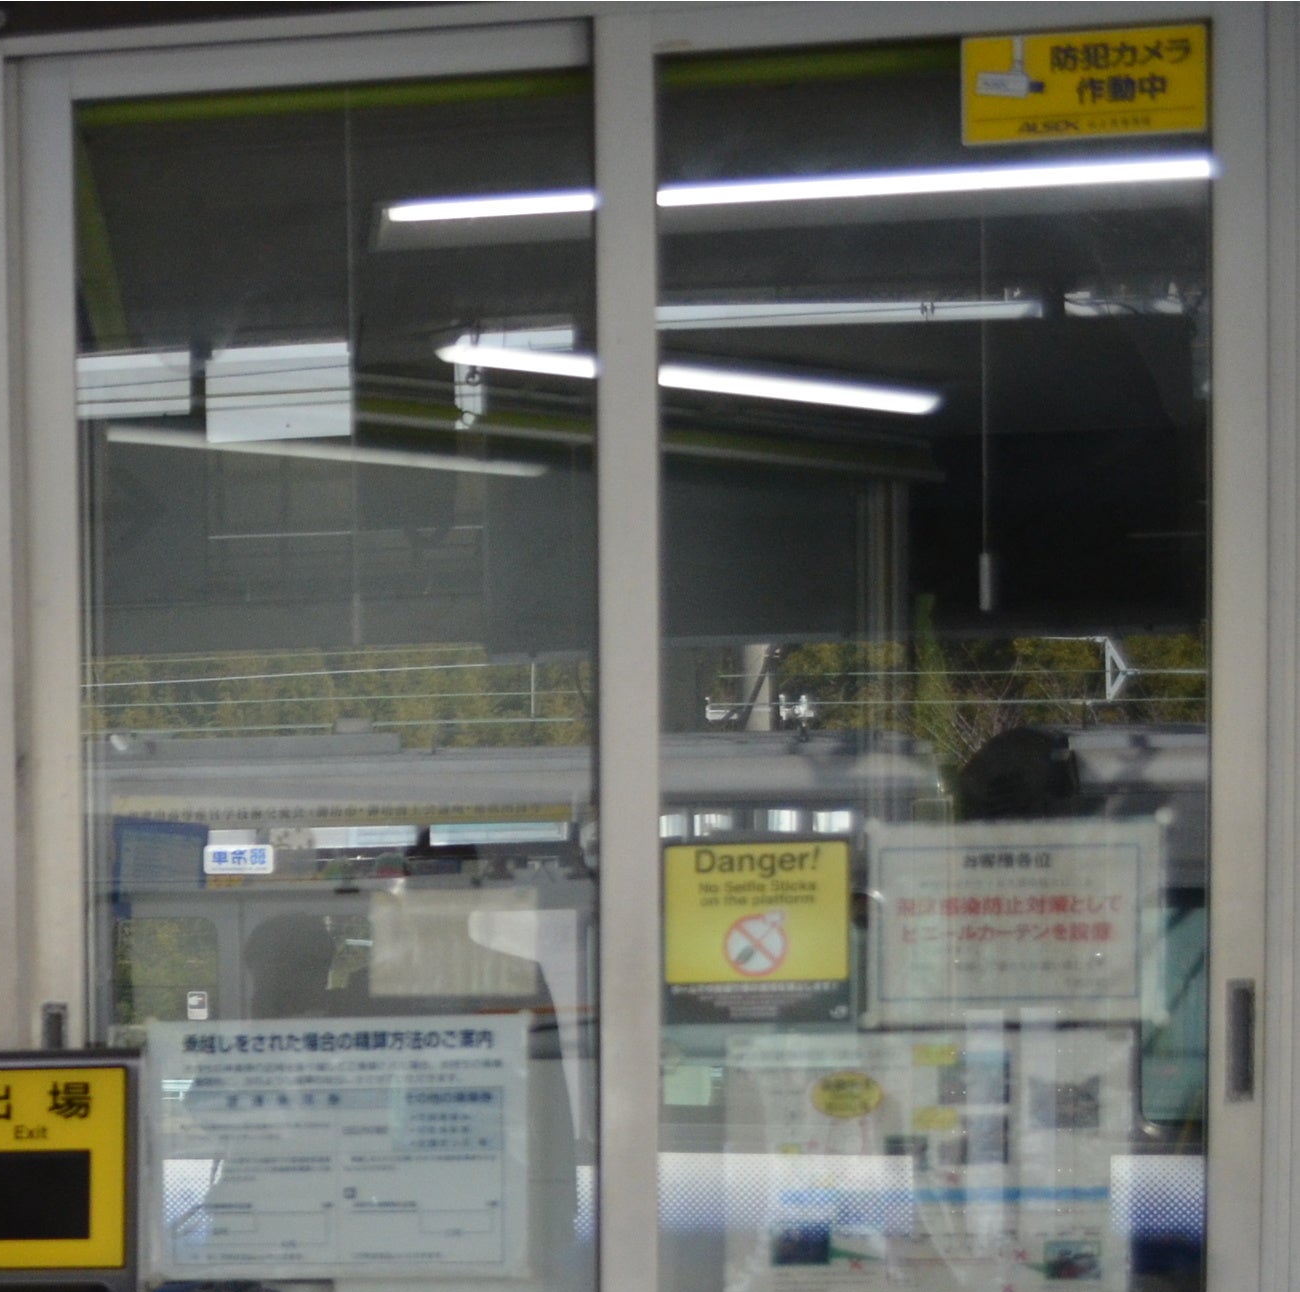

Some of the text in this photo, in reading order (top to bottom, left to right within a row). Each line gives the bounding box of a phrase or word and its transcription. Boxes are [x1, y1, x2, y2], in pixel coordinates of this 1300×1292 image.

[1051, 38, 1191, 72] 防犯カメラ
[1076, 73, 1167, 104] 作動中
[694, 845, 820, 879] Danger!
[13, 1124, 49, 1140] Exit
